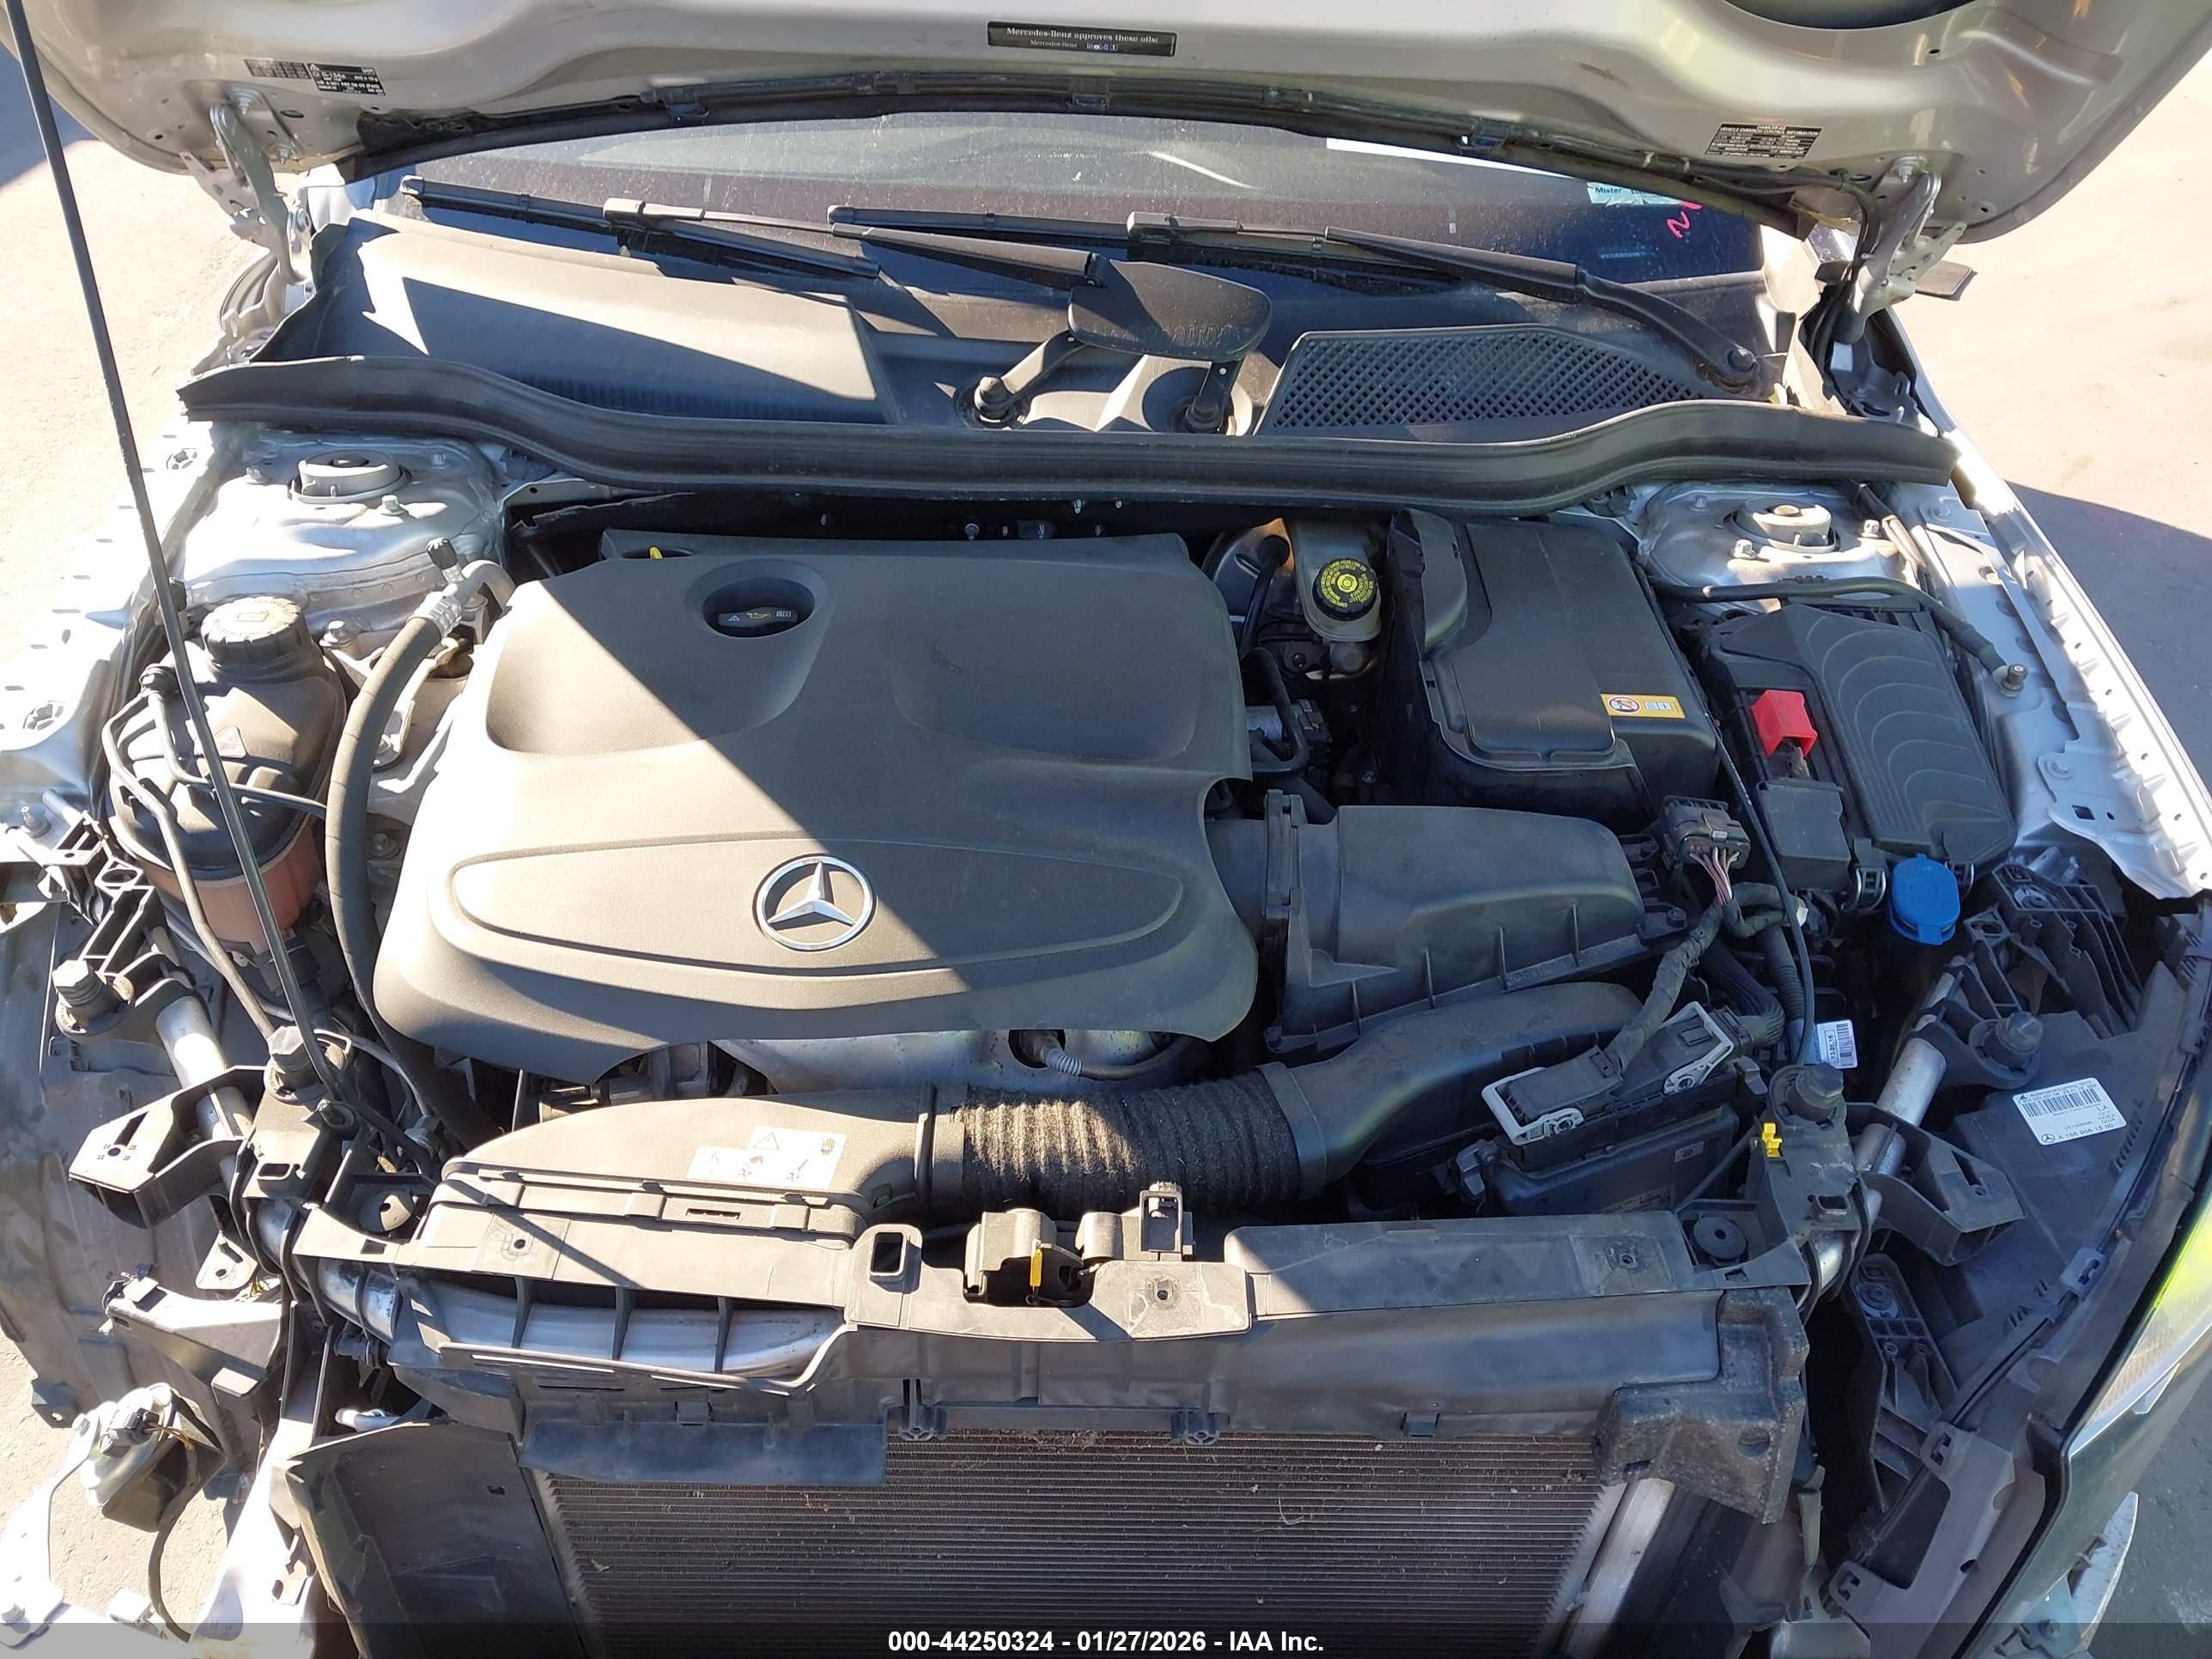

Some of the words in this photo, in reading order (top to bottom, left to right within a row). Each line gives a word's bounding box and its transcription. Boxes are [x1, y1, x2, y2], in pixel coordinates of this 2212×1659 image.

[1006, 27, 1072, 39] Mercedes-Benz
[1074, 33, 1113, 42] approves
[1115, 33, 1139, 43] these
[1030, 39, 1078, 48] Mercedes-Benz
